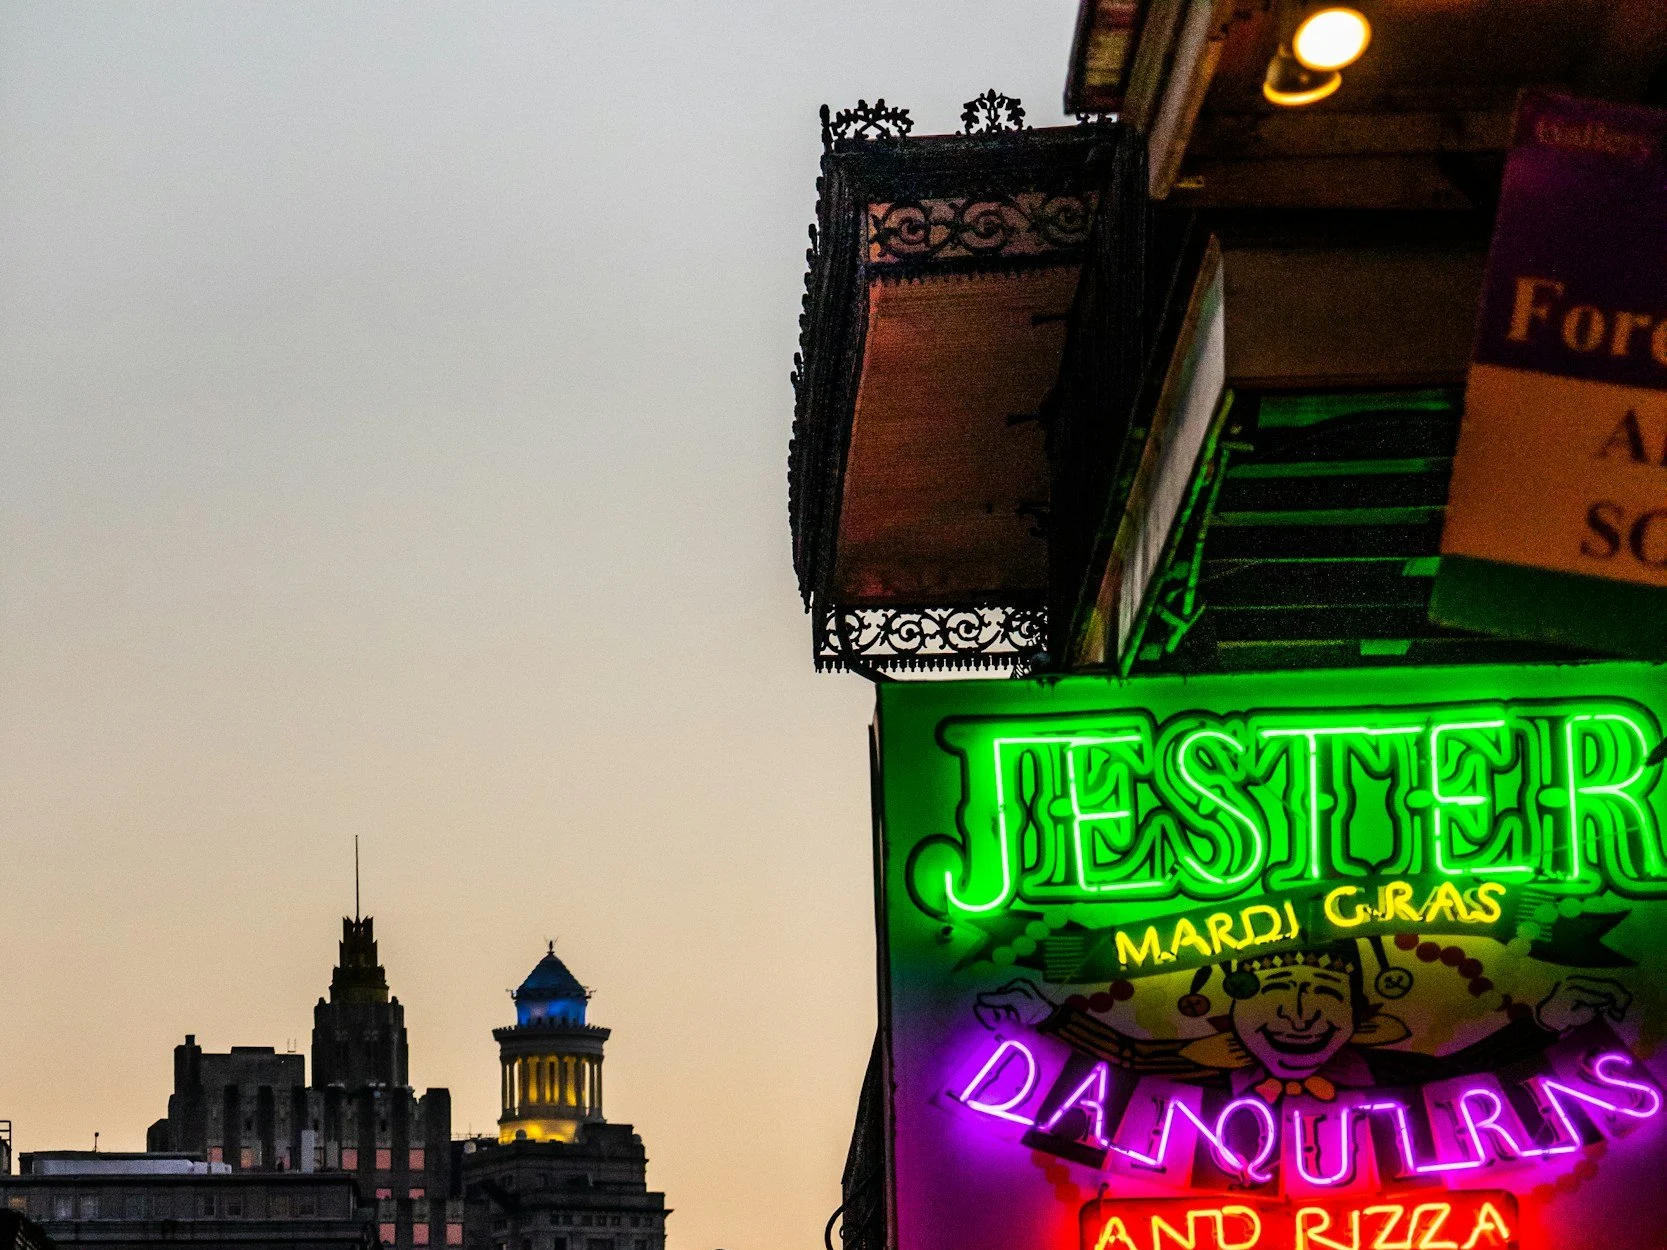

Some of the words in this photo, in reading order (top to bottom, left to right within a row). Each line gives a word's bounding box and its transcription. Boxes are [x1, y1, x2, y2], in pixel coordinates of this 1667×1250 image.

[1595, 408, 1667, 468] A
[918, 699, 1667, 914] JESTER
[1115, 900, 1299, 970] MARDI
[1323, 880, 1506, 928] GRAS
